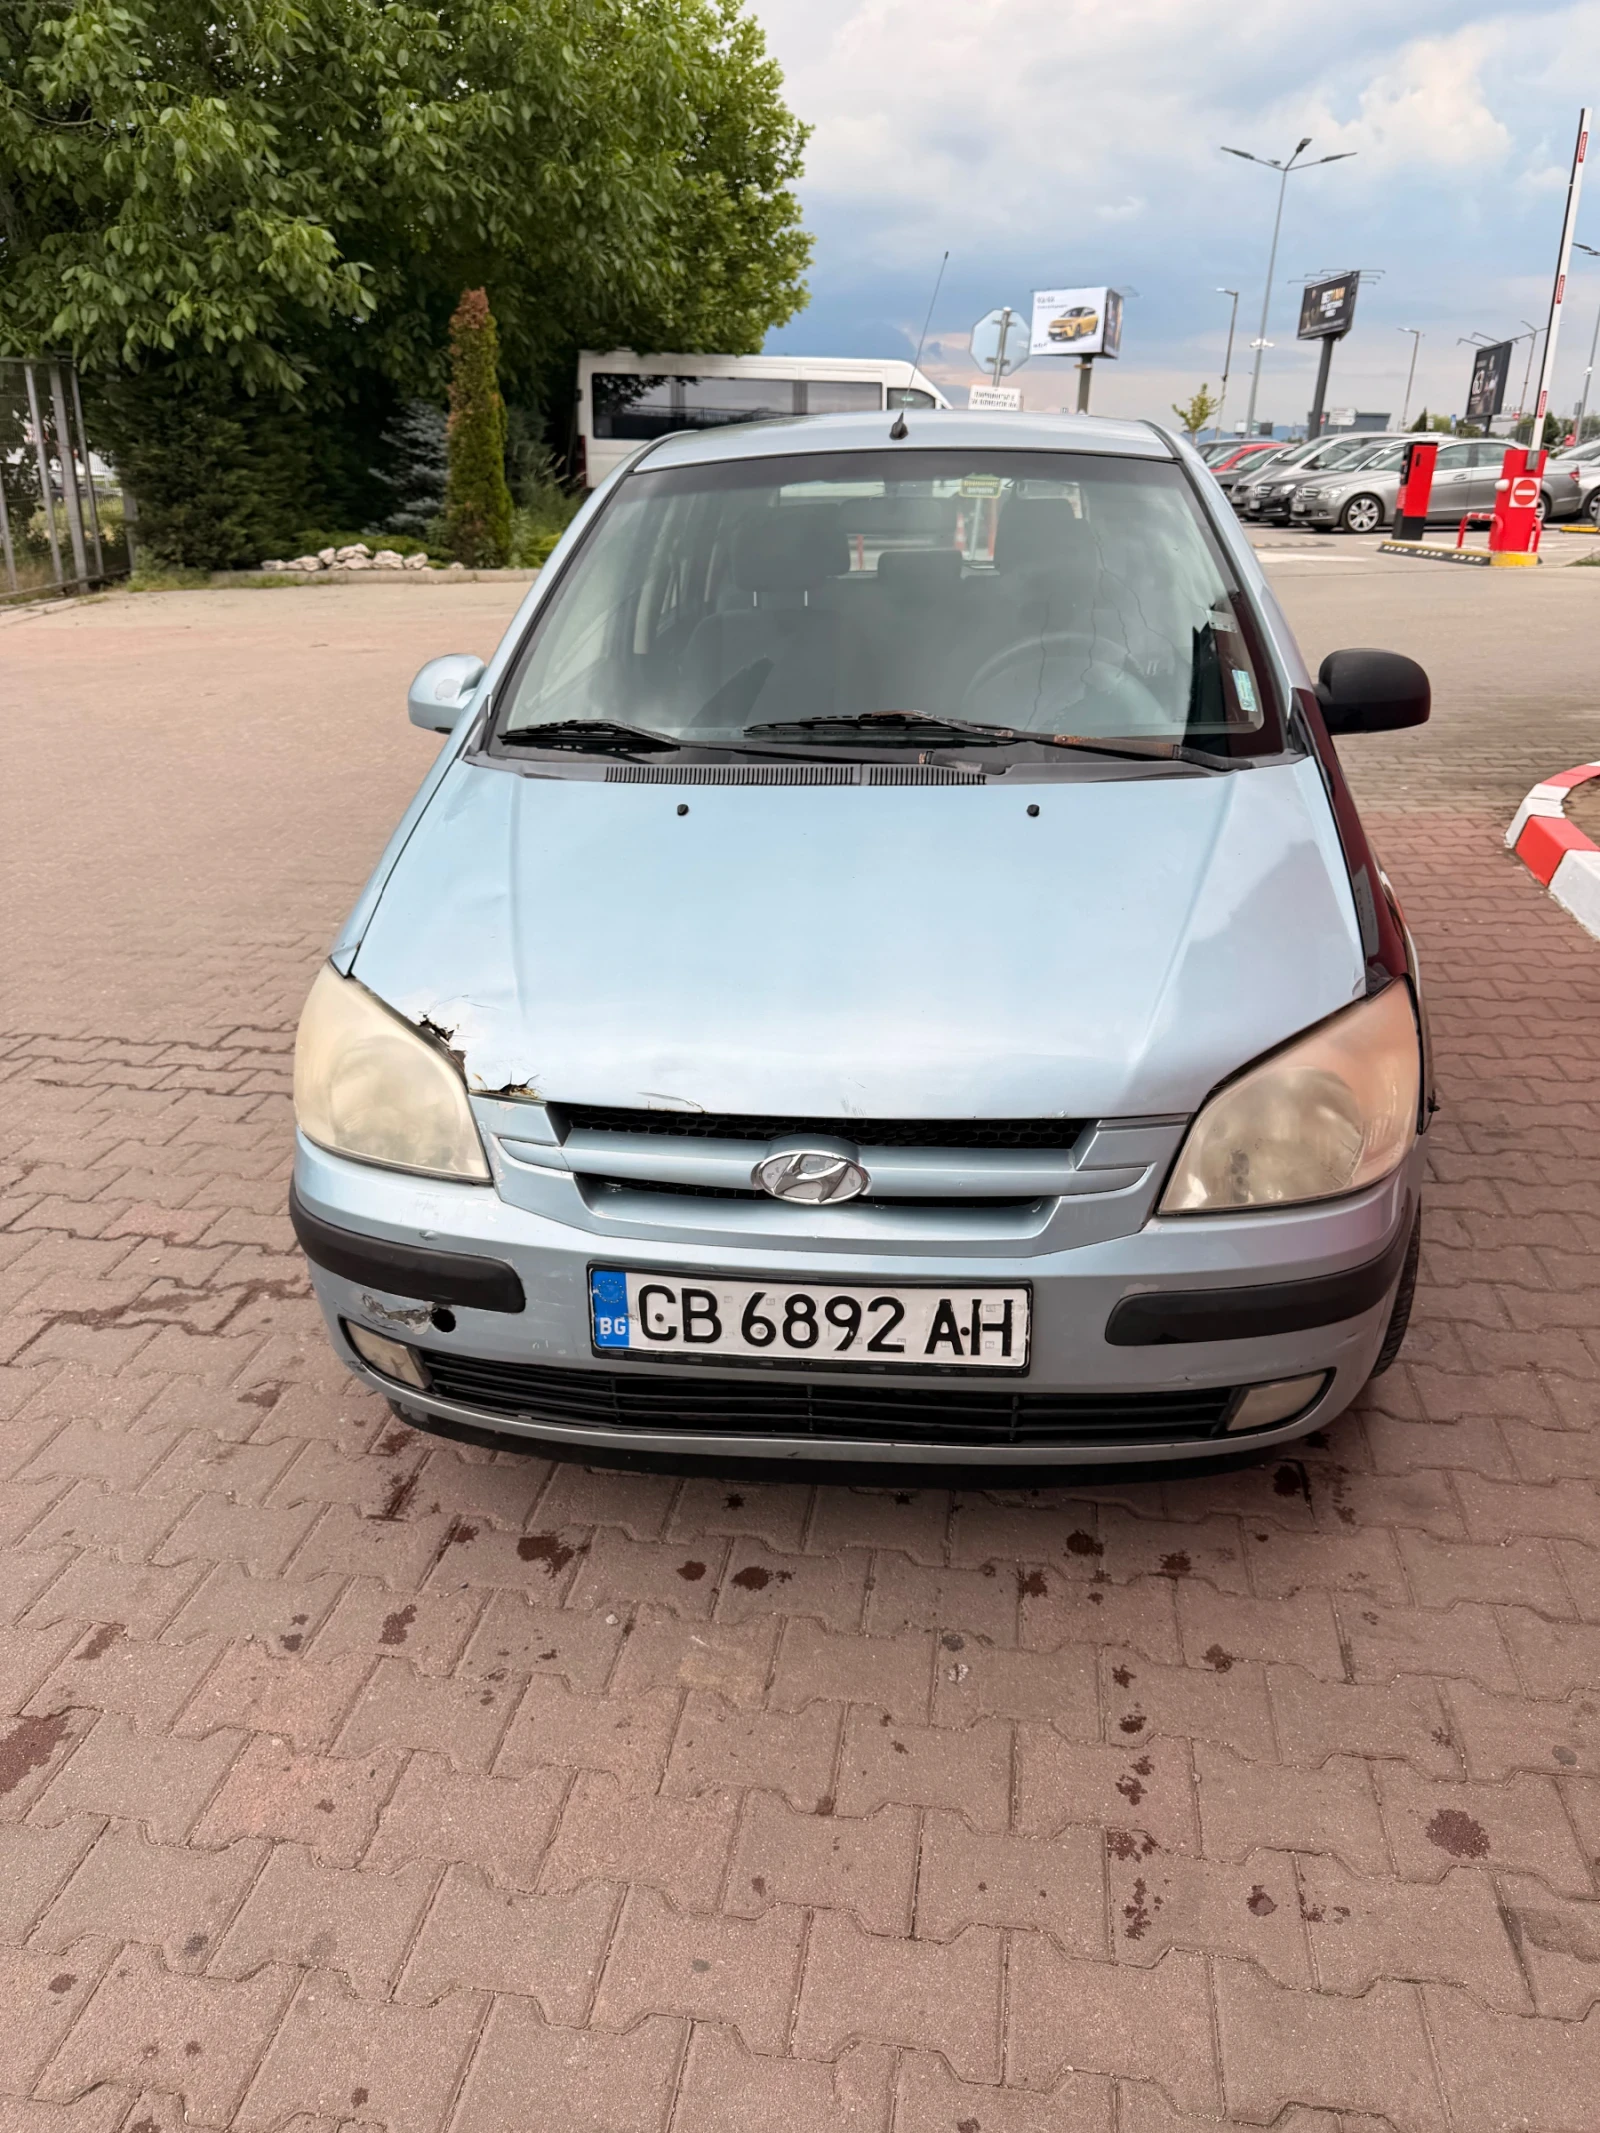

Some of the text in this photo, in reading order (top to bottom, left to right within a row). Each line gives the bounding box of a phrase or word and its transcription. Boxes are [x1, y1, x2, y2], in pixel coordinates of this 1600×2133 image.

[600, 1317, 627, 1336] BG
[638, 1284, 1014, 1357] CB 6892 AH
